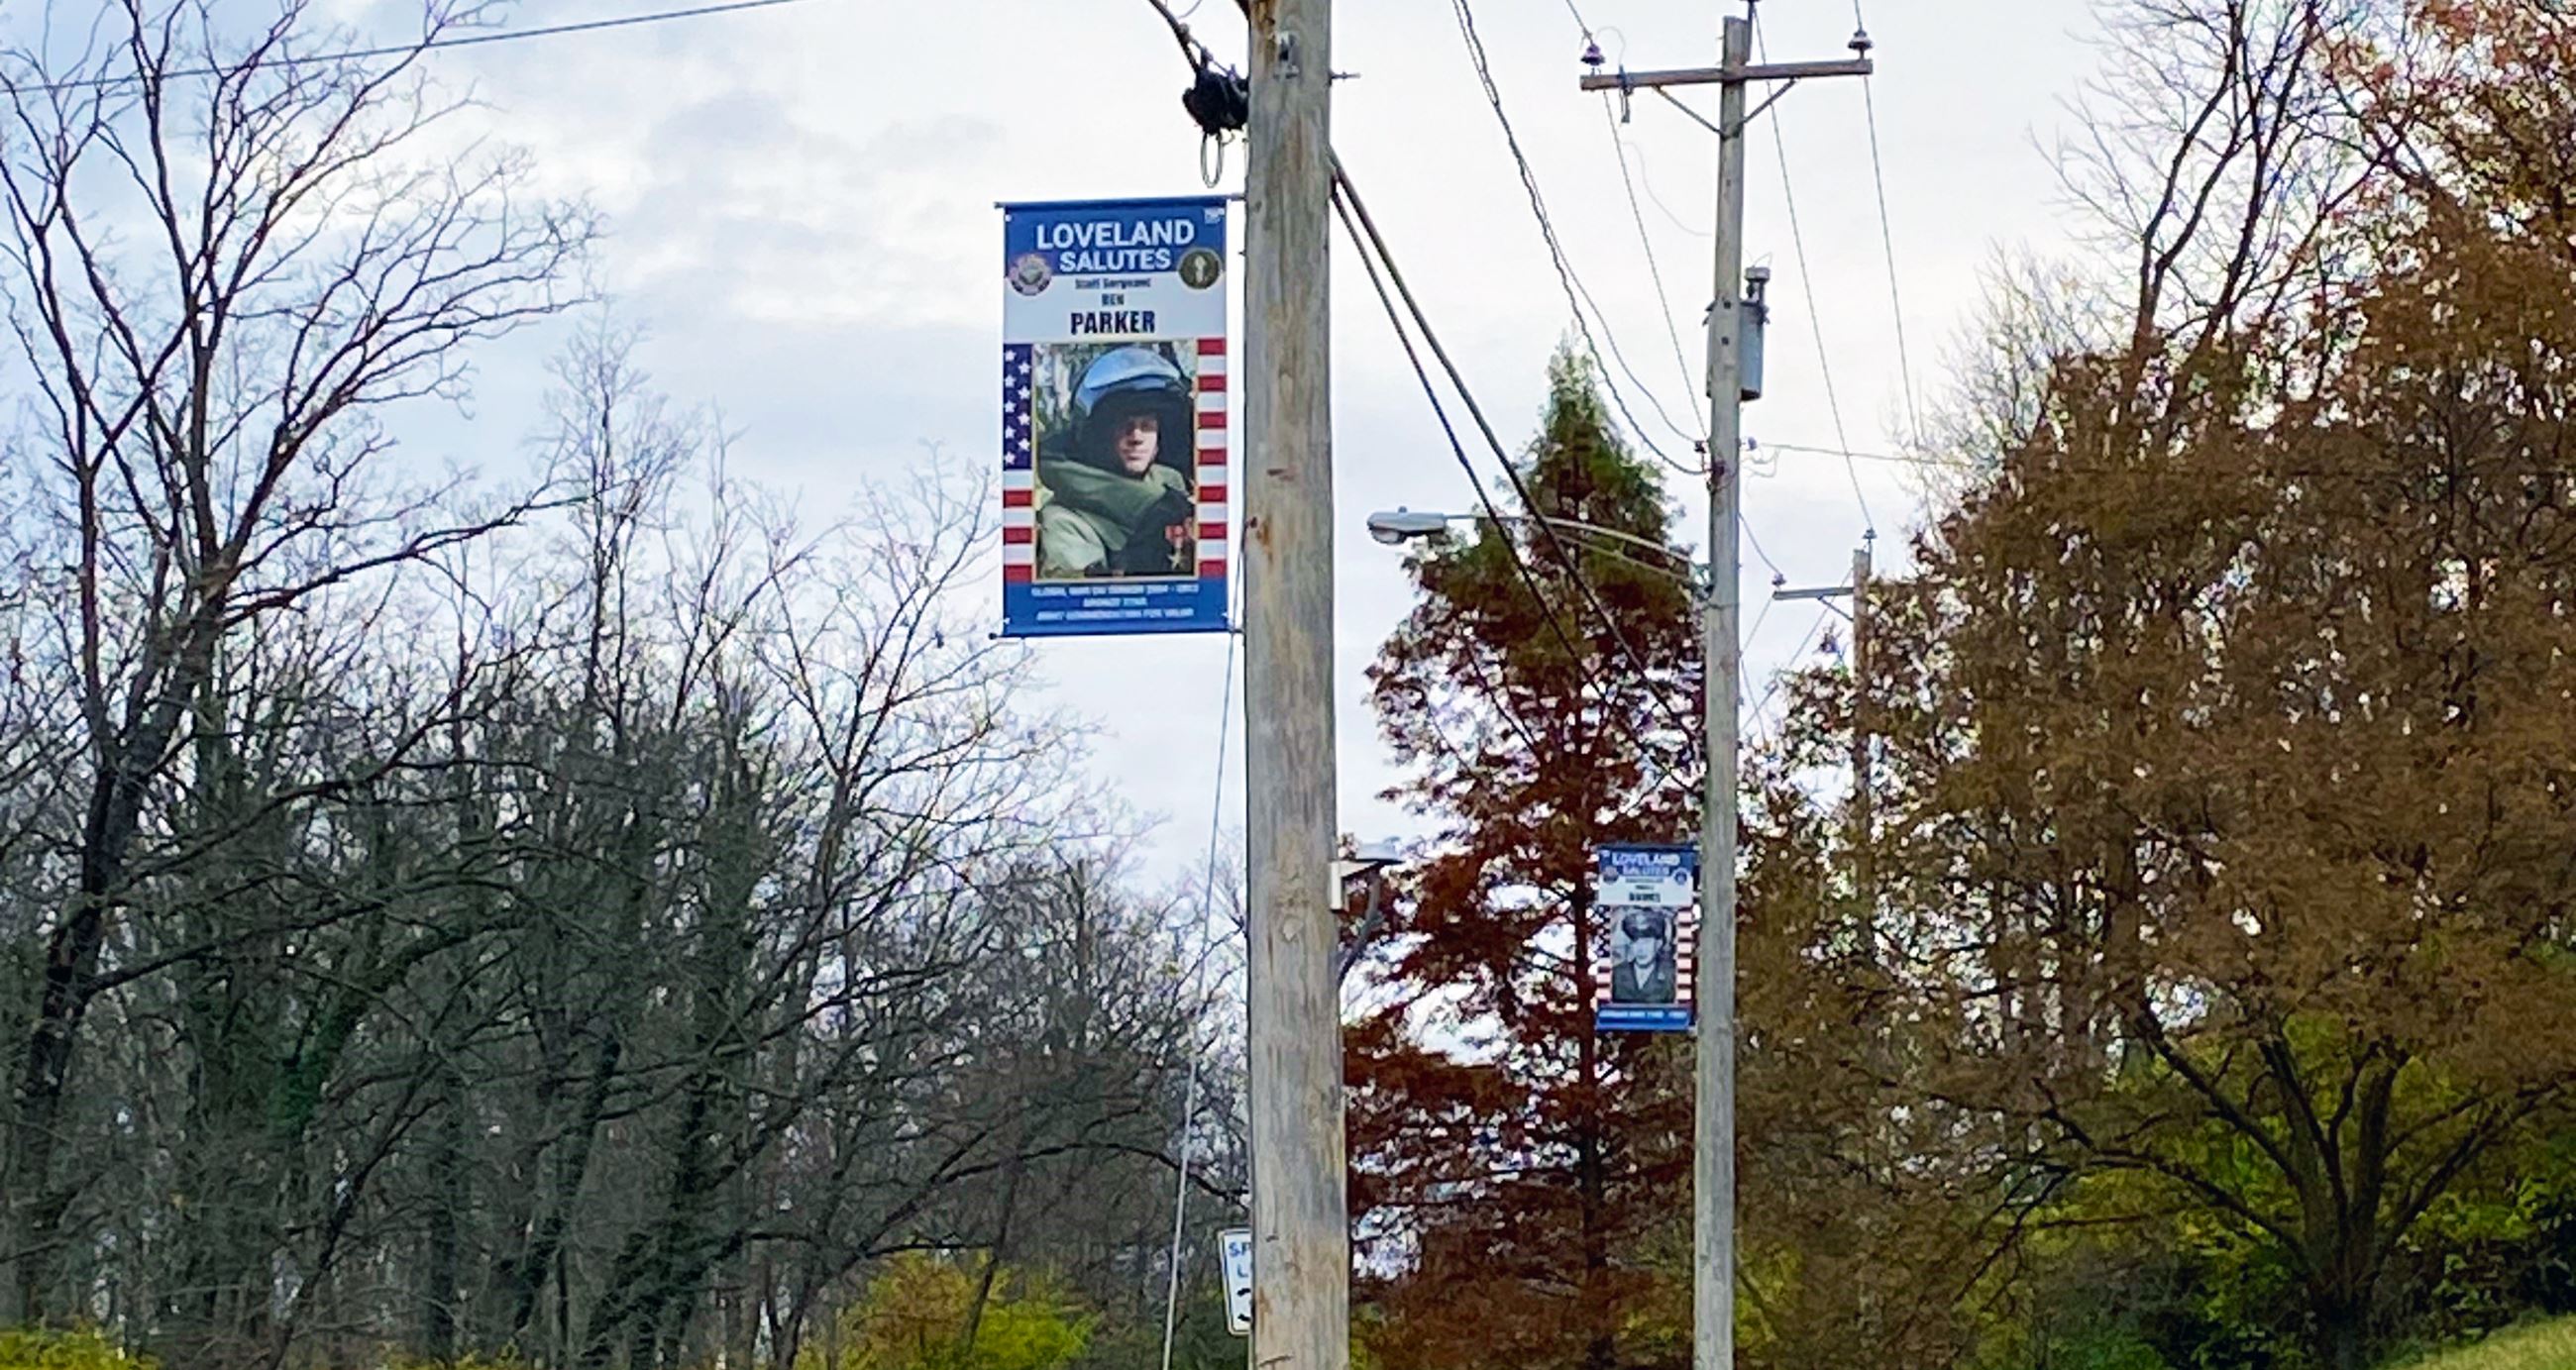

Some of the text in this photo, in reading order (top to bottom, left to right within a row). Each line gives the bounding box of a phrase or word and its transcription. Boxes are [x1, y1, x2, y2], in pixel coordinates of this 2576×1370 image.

[1036, 219, 1195, 250] LOVELAND
[1059, 249, 1171, 272] SALUTES
[1070, 310, 1156, 335] PARKER
